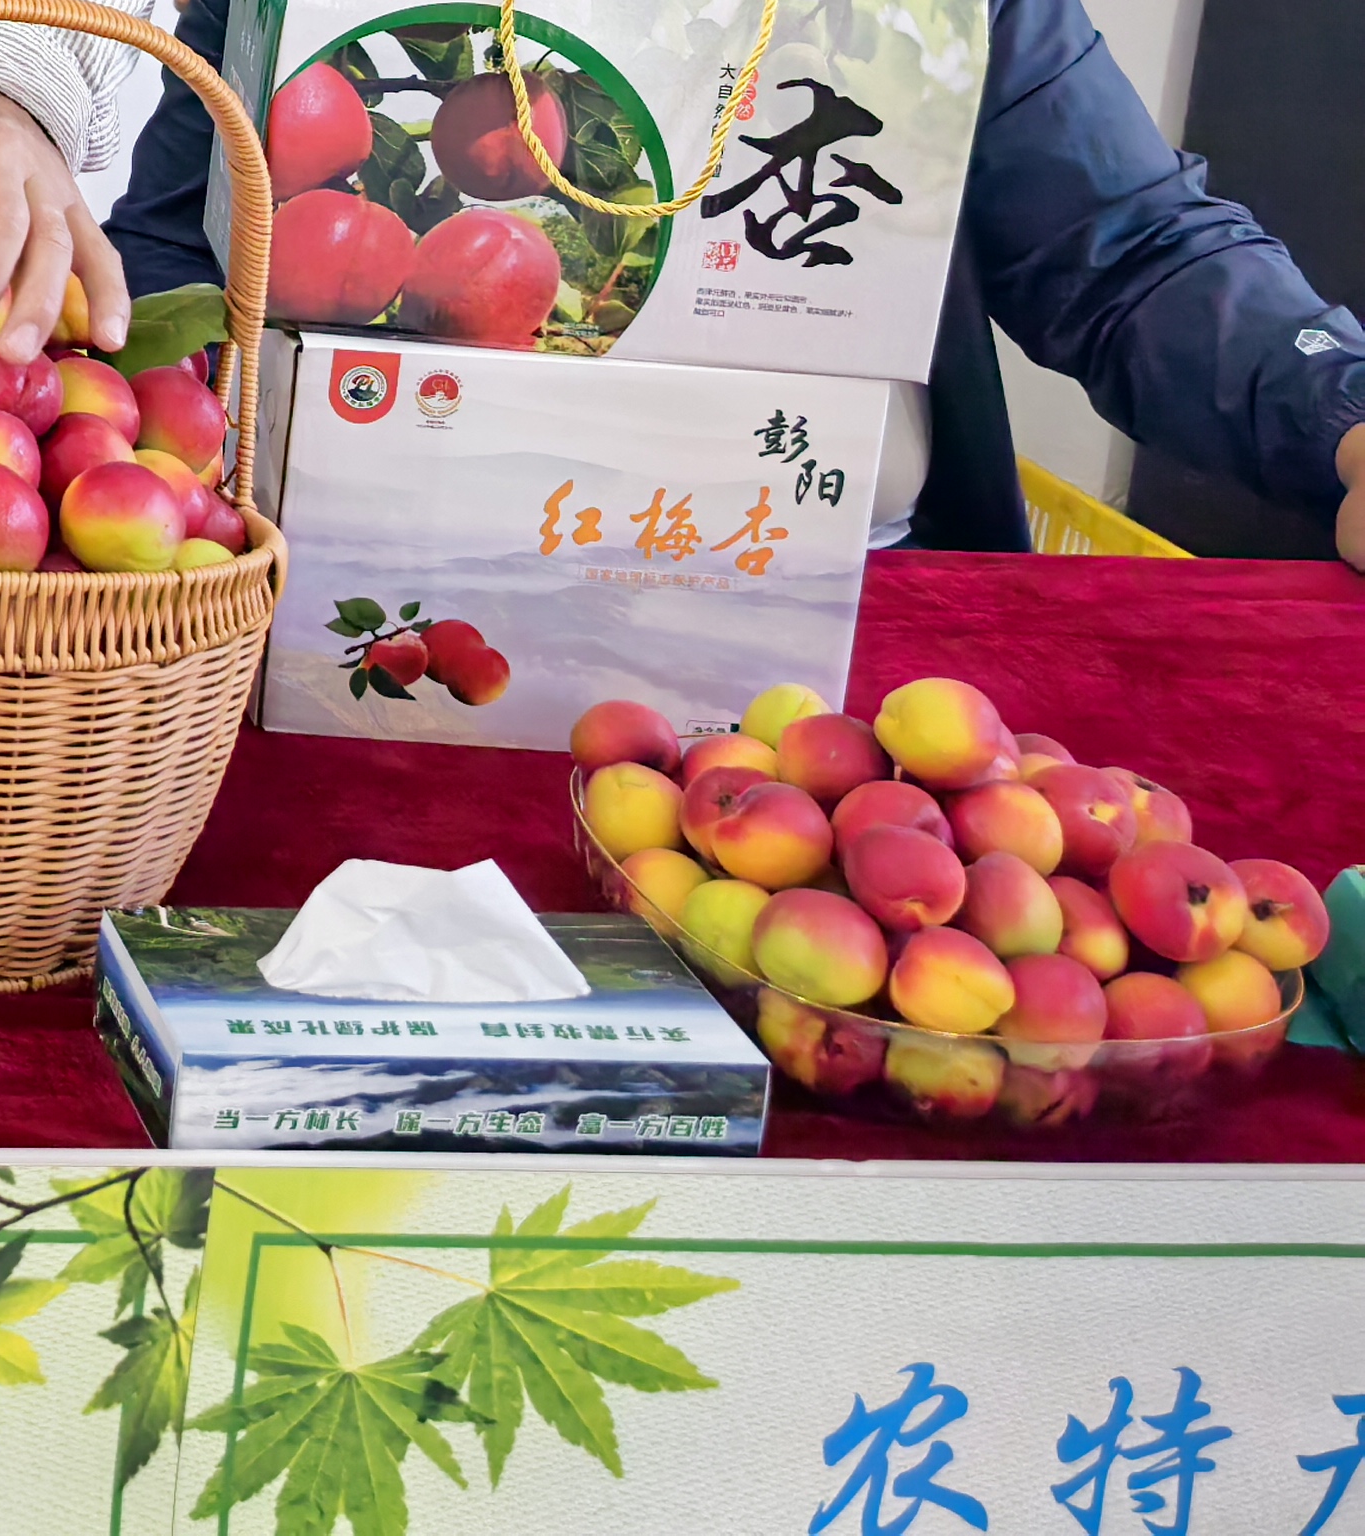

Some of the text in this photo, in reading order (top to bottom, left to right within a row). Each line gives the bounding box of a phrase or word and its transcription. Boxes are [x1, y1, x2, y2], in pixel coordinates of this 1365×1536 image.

[753, 409, 846, 508] 彭阳
[538, 478, 789, 577] 红梅杏
[213, 1108, 730, 1141] 当一方林长 保一方生态 富一方百姓
